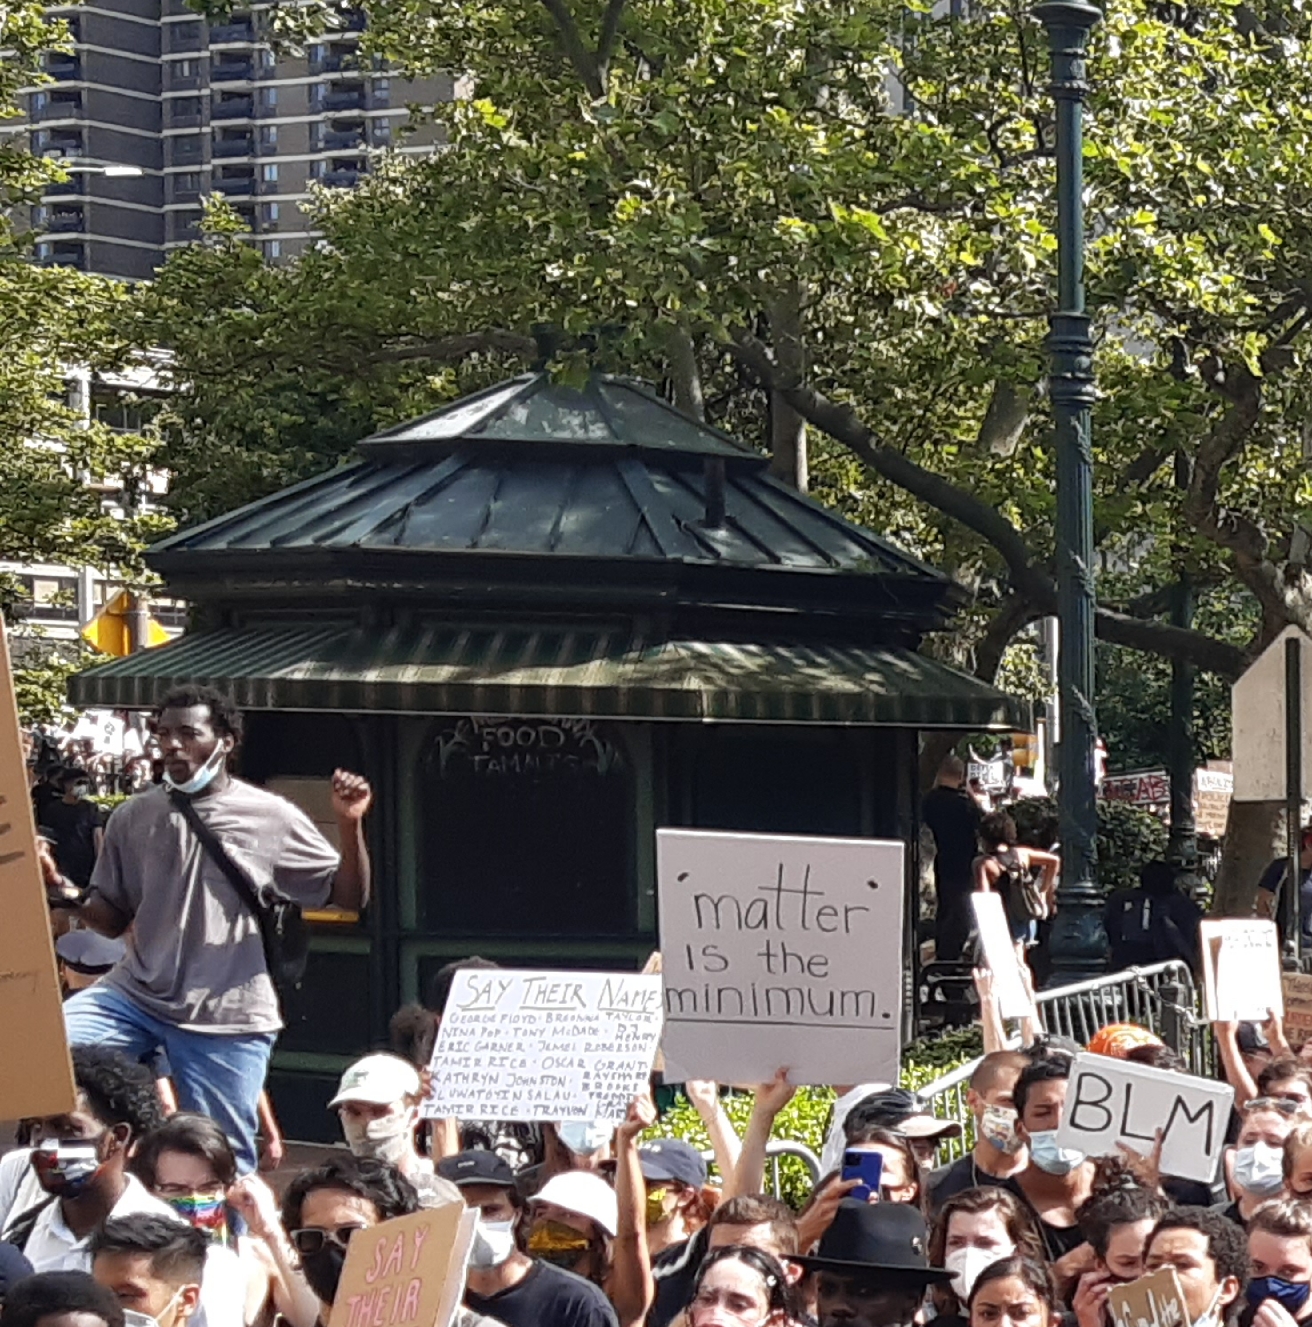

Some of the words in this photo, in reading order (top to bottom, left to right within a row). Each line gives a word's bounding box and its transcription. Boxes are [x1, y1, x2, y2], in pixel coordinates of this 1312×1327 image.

[757, 940, 829, 978] the
[457, 975, 514, 1009] SAY
[520, 977, 587, 1008] THEIR
[450, 1012, 496, 1024] GEORGE
[500, 1012, 537, 1024] FLOYD
[606, 1011, 652, 1023] TAYLOR
[442, 1027, 476, 1038] NINA
[513, 1027, 546, 1038] TONY
[437, 1041, 470, 1053] ERIC
[474, 1041, 526, 1052] GARNER
[584, 1041, 647, 1052] ROBERSON
[433, 1056, 481, 1068] TAMIR
[487, 1056, 527, 1068] RICE
[542, 1056, 586, 1068] OSCAR
[594, 1060, 647, 1071] GRANT
[430, 1073, 499, 1085] KATHRYN
[505, 1073, 566, 1085] JOHNSTON
[424, 1103, 474, 1115] TAMIR
[480, 1104, 519, 1116] RICE
[1069, 1072, 1214, 1156] BLM
[366, 1223, 430, 1284] SAY
